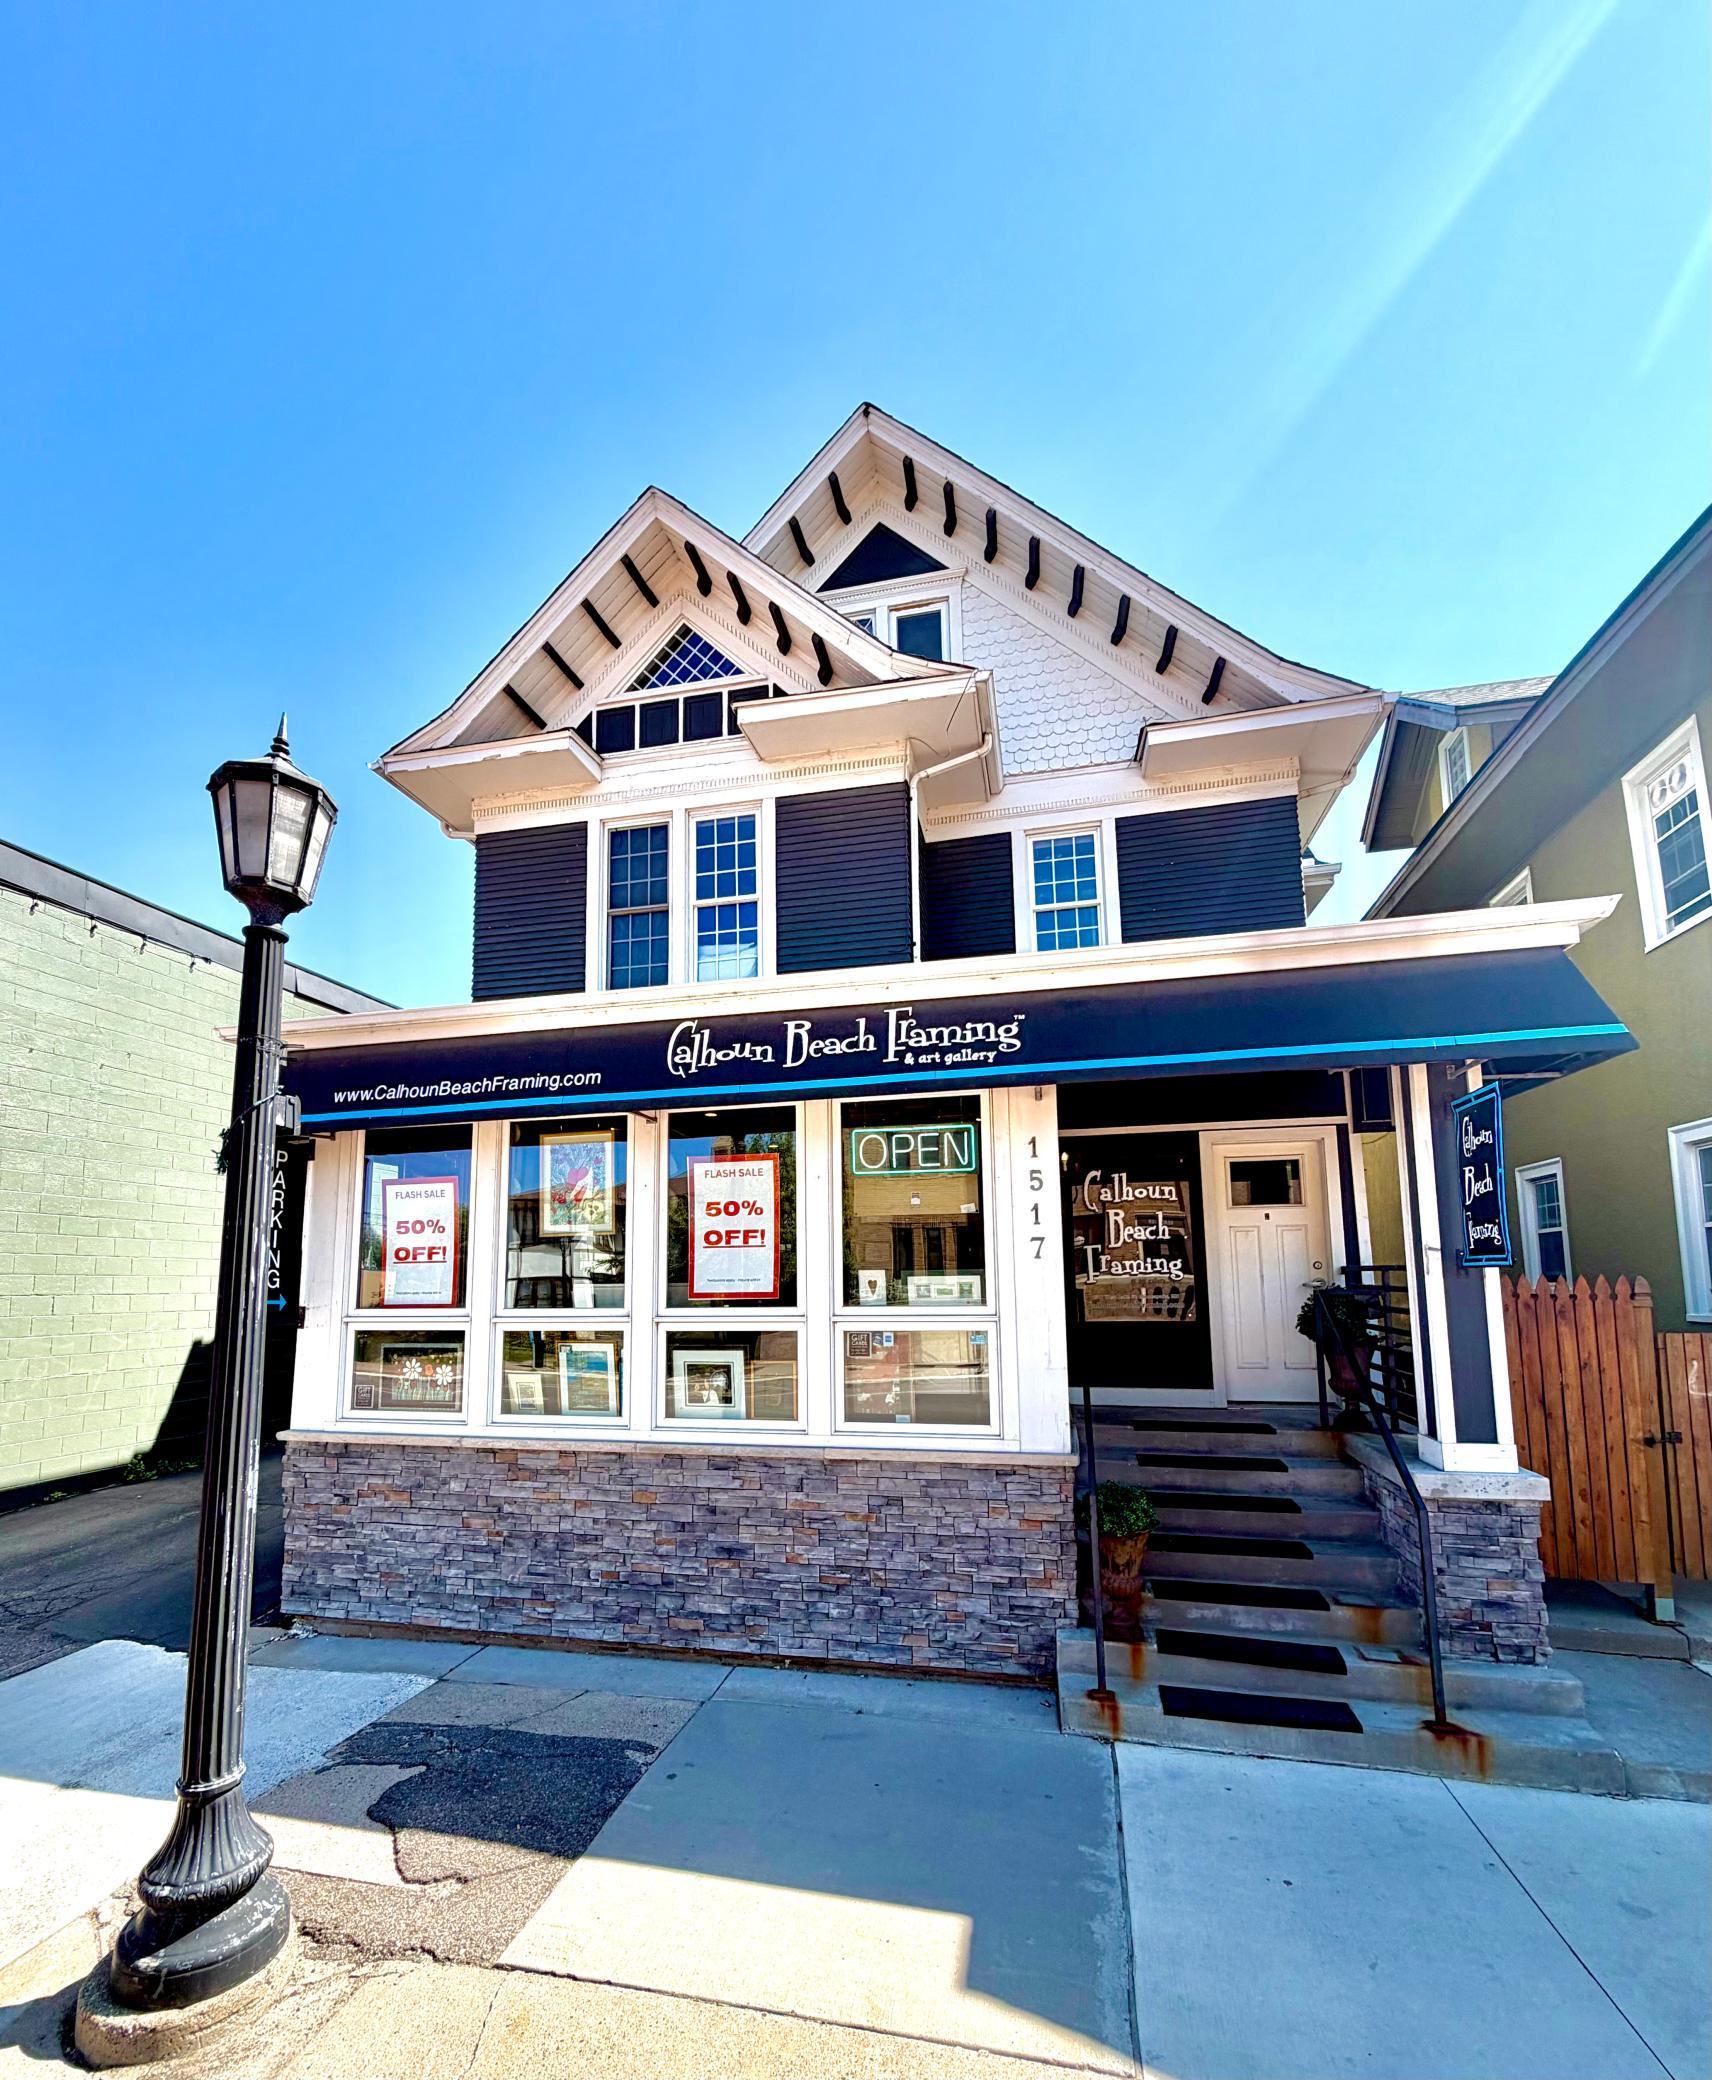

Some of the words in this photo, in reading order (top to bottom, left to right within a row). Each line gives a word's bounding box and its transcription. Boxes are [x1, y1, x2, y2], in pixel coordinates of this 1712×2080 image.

[667, 1019, 775, 1078] Calhoun
[783, 1018, 877, 1068] Beach
[904, 1052, 915, 1065] &
[918, 1051, 941, 1064] art
[944, 1048, 998, 1066] gallery
[333, 1070, 602, 1103] www.CalhounBeachFraming.com
[859, 1131, 969, 1169] OPEN
[1462, 1116, 1493, 1158] Calhoun
[704, 1168, 737, 1179] FLASH
[738, 1167, 764, 1178] SALE
[1462, 1162, 1494, 1206] Beach
[395, 1190, 422, 1200] FLASH
[424, 1189, 446, 1199] SALE
[705, 1200, 764, 1217] 50%
[1083, 1169, 1178, 1213] Calhoun
[266, 1150, 288, 1289] PARKING
[395, 1219, 446, 1235] 50%
[1106, 1209, 1171, 1249] Beach
[393, 1246, 447, 1262] OFF!
[703, 1229, 766, 1246] OFF!
[1083, 1245, 1184, 1284] Framing
